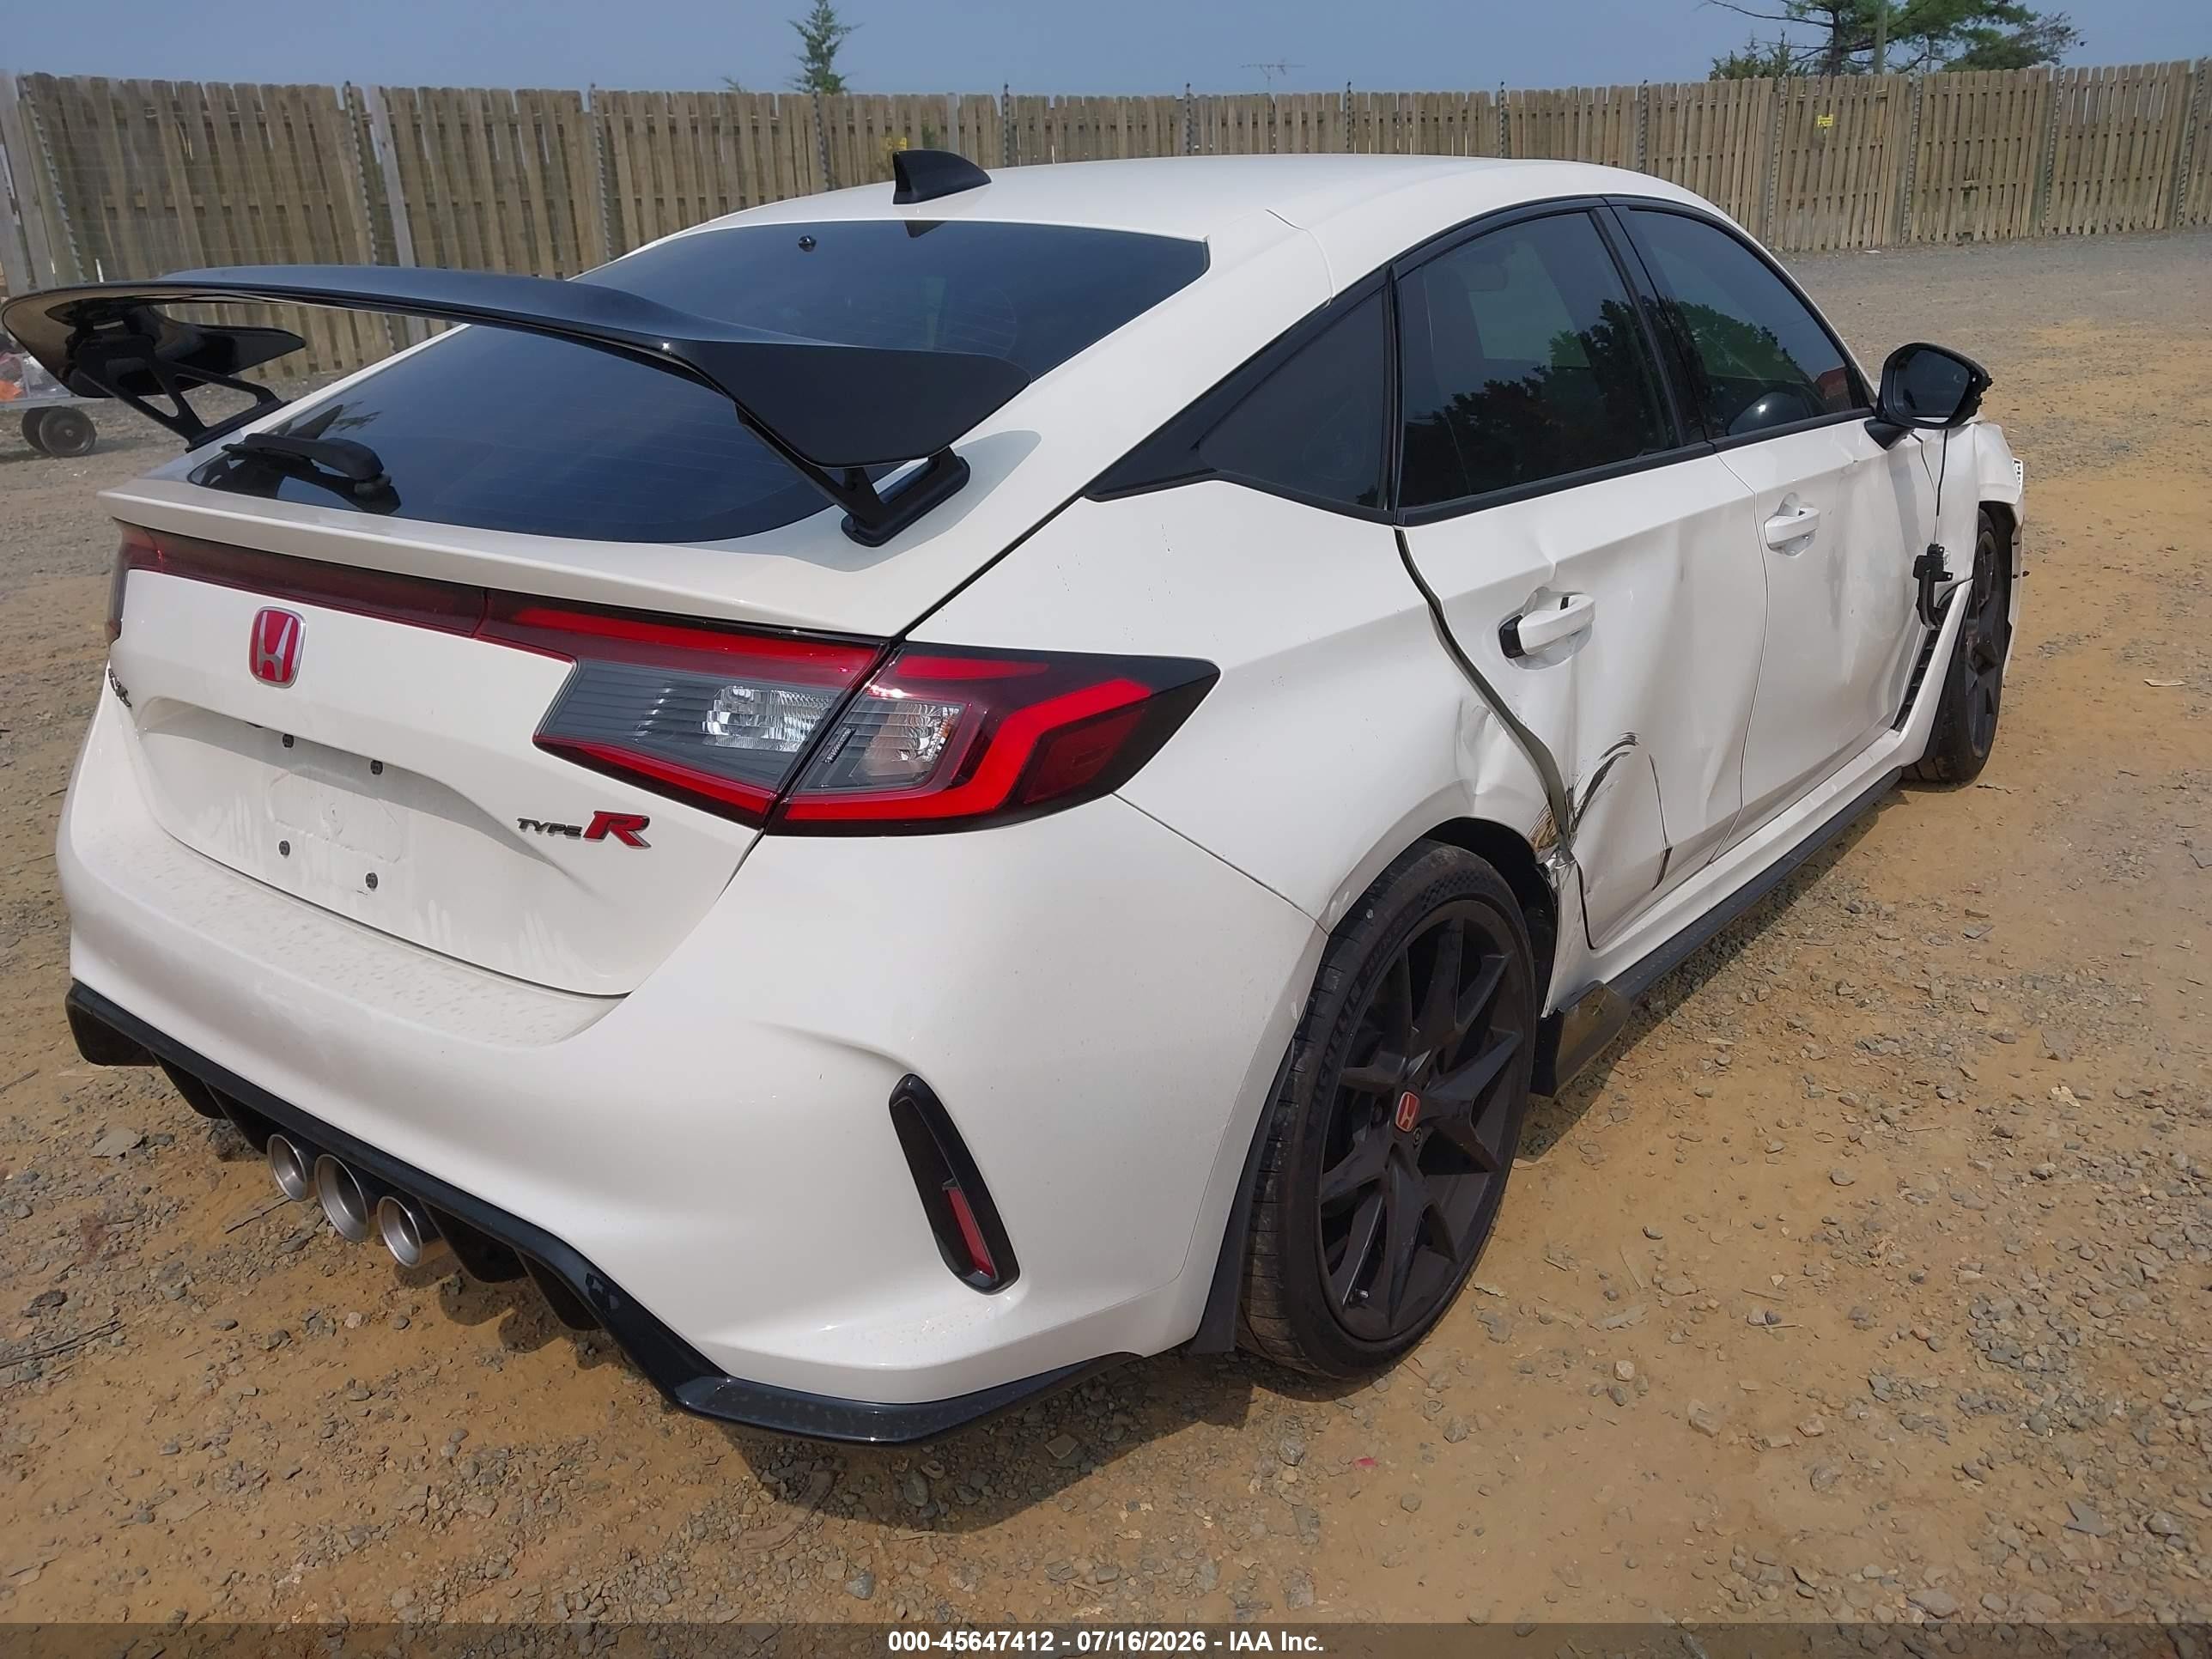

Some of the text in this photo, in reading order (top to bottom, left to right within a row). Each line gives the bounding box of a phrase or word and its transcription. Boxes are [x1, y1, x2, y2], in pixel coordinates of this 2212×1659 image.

[257, 610, 295, 682] H
[516, 810, 653, 848] TYPE R
